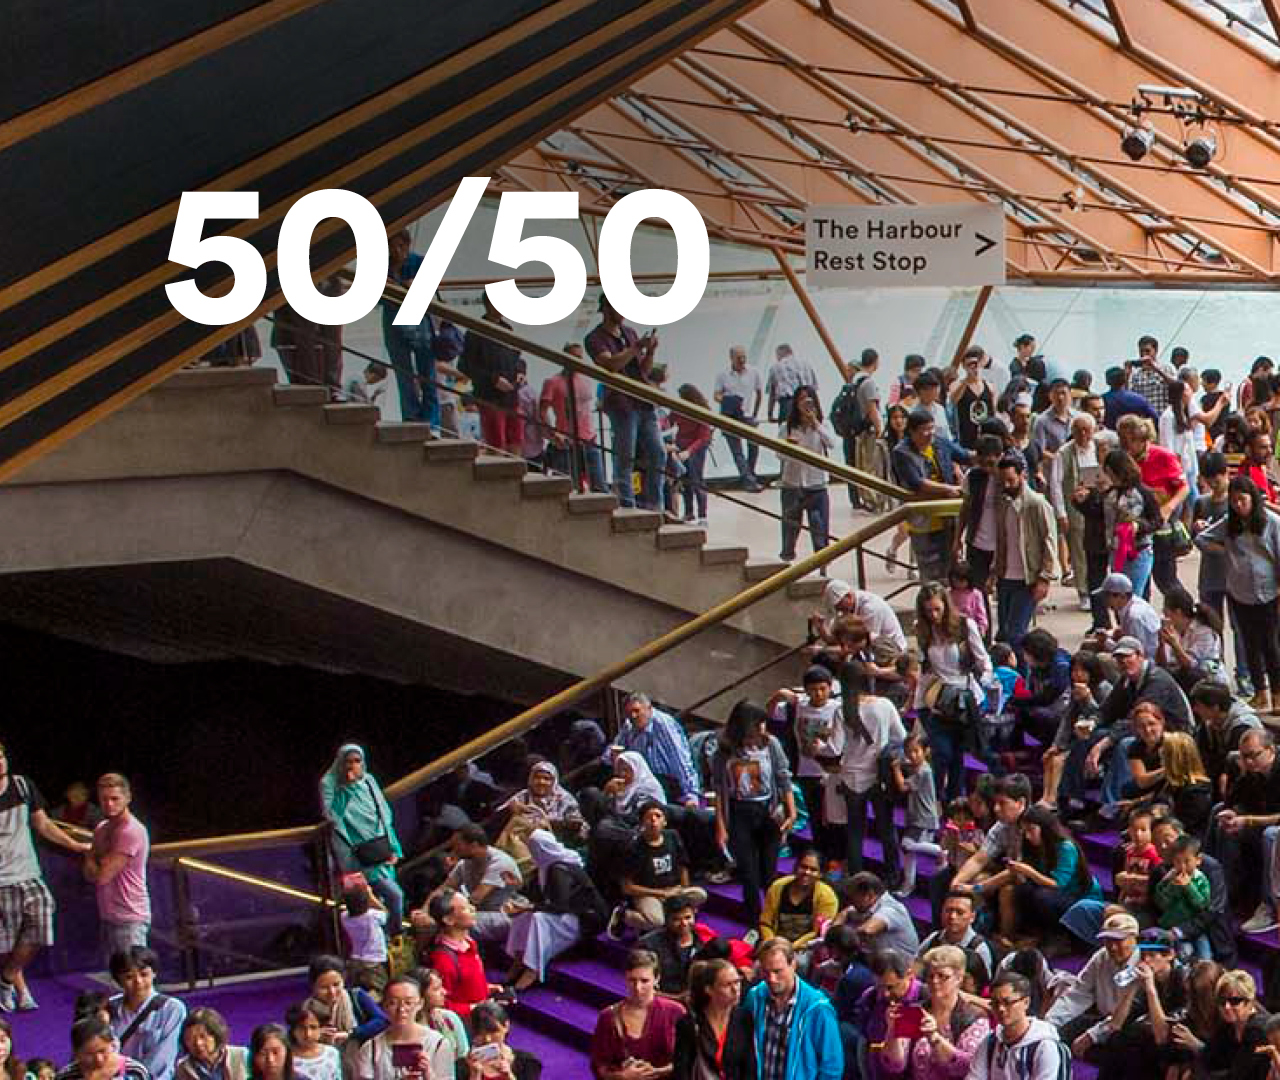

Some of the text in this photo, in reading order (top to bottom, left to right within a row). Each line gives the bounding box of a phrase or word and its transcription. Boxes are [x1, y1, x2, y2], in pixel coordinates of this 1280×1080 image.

[813, 218, 964, 240] The Harbour
[814, 250, 928, 276] Rest Stop
